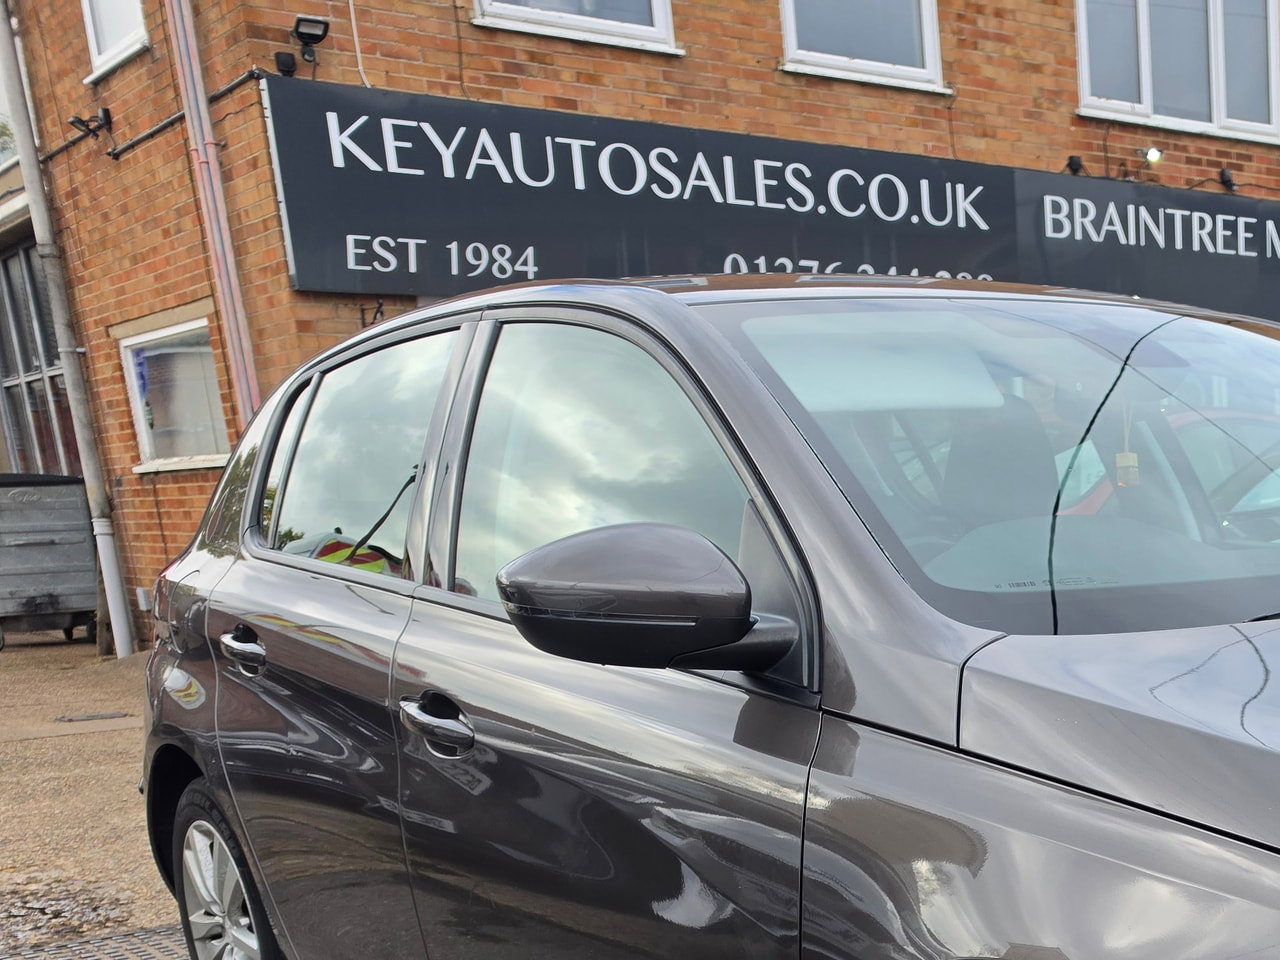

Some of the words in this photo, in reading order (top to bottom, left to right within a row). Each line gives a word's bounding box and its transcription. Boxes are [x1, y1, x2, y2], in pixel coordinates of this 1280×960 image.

[325, 111, 990, 231] KEYAUTOSALES.CO.UK
[345, 234, 427, 273] EST
[445, 240, 539, 280] 1984
[1043, 194, 1258, 257] BRAINTREE
